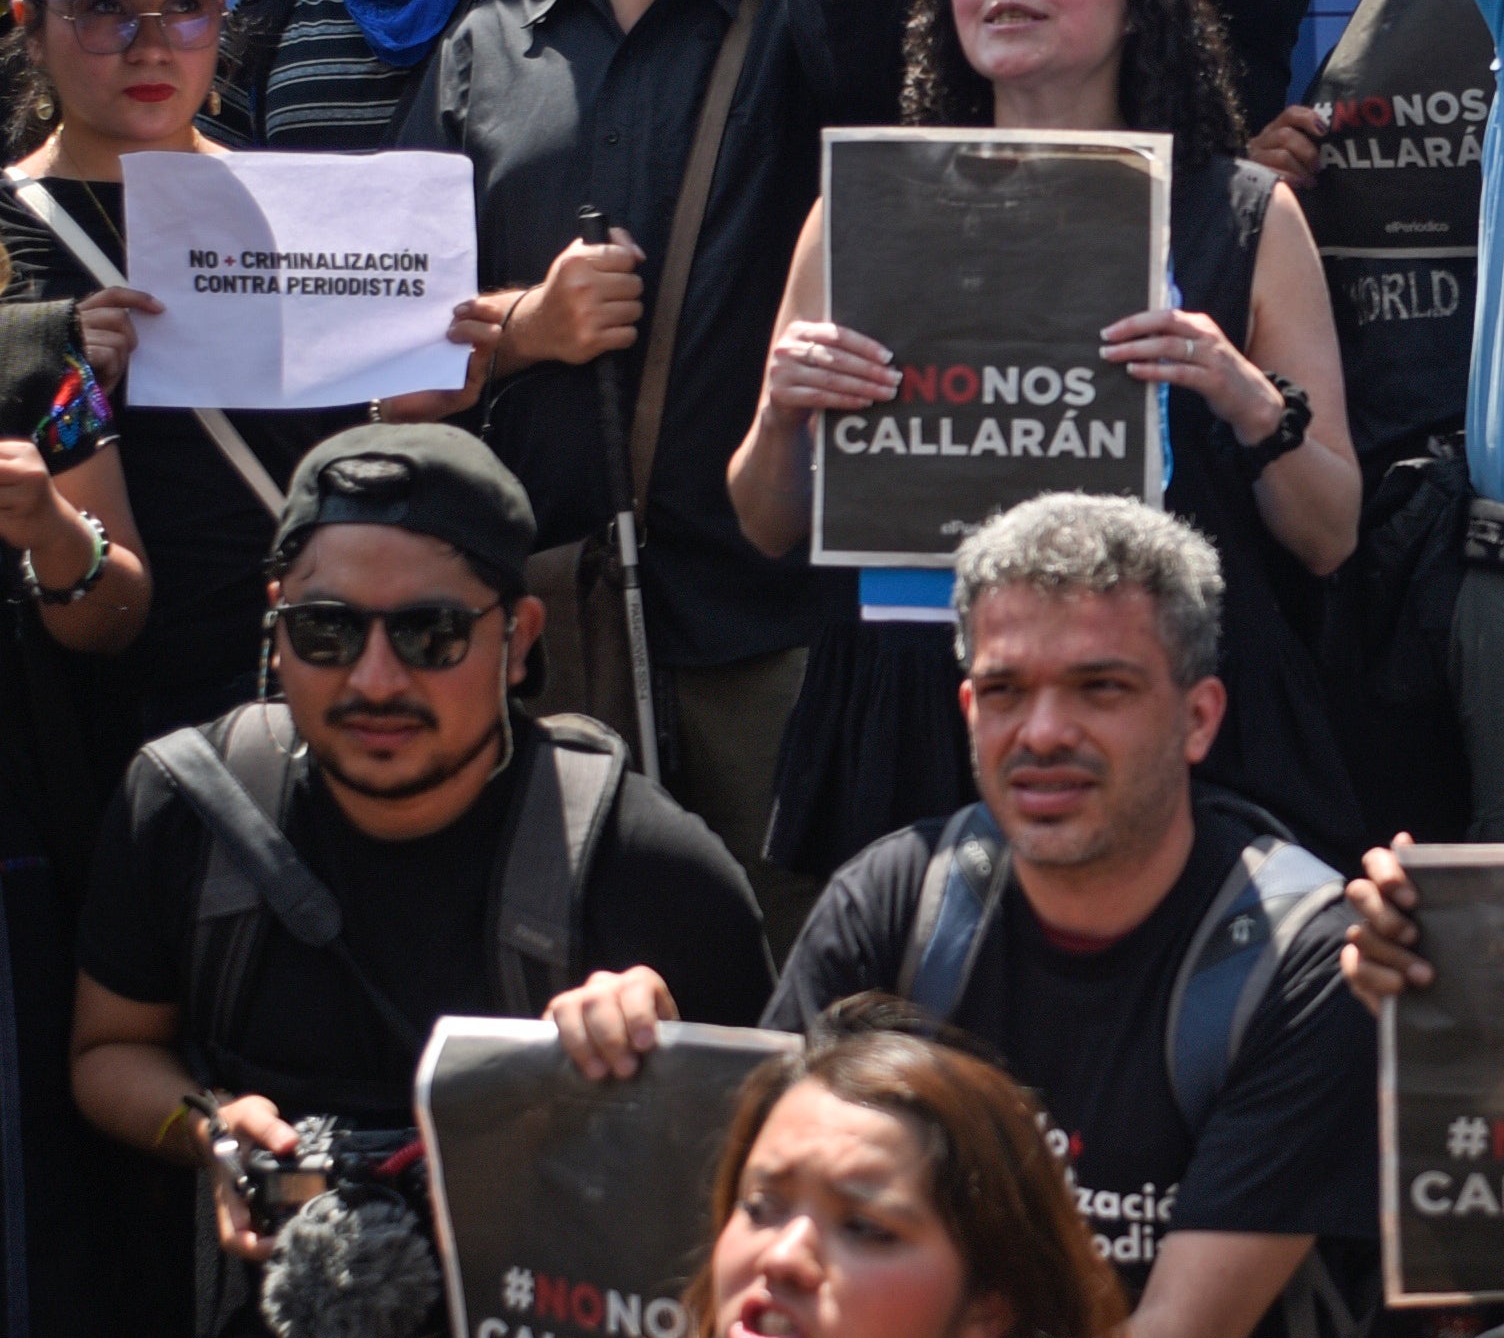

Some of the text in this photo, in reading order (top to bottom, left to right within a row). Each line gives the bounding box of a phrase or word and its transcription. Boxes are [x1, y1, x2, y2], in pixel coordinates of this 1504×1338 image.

[1319, 126, 1483, 169] ALLARÁ
[188, 249, 218, 270] NO
[240, 249, 429, 274] CRIMINALIZACIÓN
[193, 274, 425, 299] CONTRA PERIODISTAS
[900, 365, 1096, 407] NONOS
[834, 409, 1127, 461] CALLARÁN
